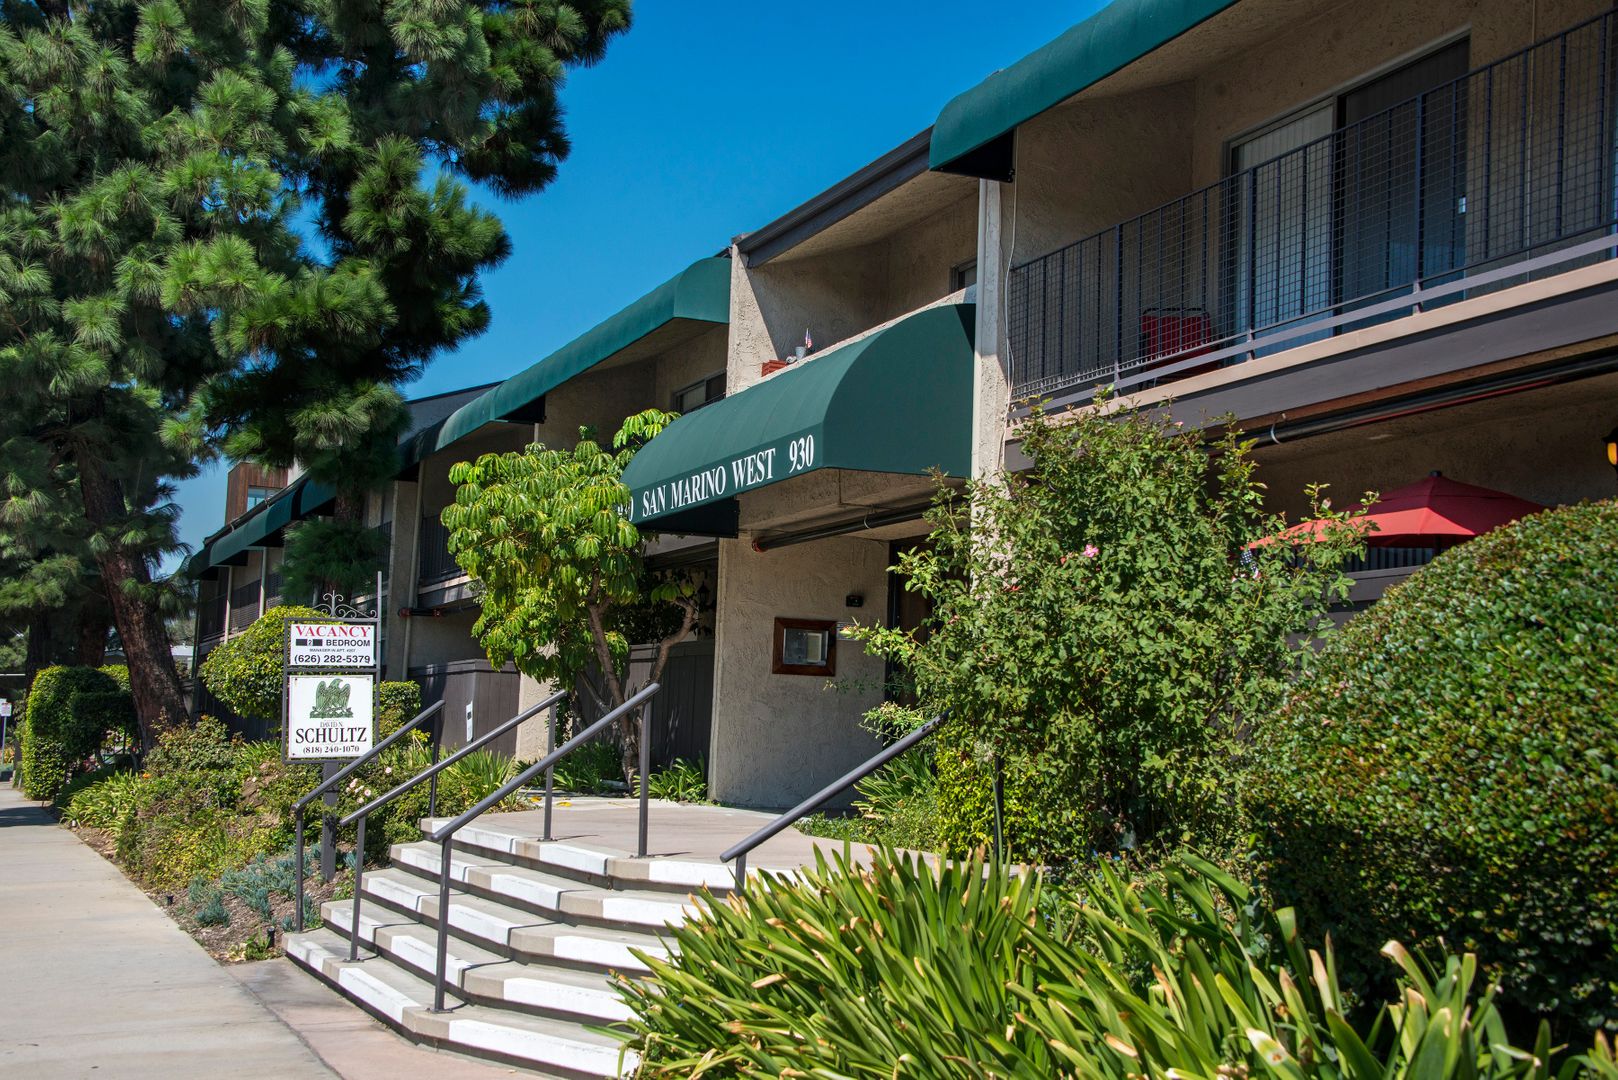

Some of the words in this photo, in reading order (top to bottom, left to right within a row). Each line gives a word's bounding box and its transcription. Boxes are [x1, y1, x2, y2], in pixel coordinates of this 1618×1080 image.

[642, 485, 667, 518] SAN
[670, 465, 727, 510] MARINO
[731, 448, 776, 490] WEST
[788, 434, 815, 474] 930
[295, 625, 371, 638] VACANCY
[325, 639, 371, 647] BEDROOM
[294, 654, 321, 665] (626)
[323, 655, 371, 664] 282-5379
[295, 727, 367, 744] SCHULTZ
[303, 746, 322, 755] (818)
[324, 745, 360, 753] 240-1070
